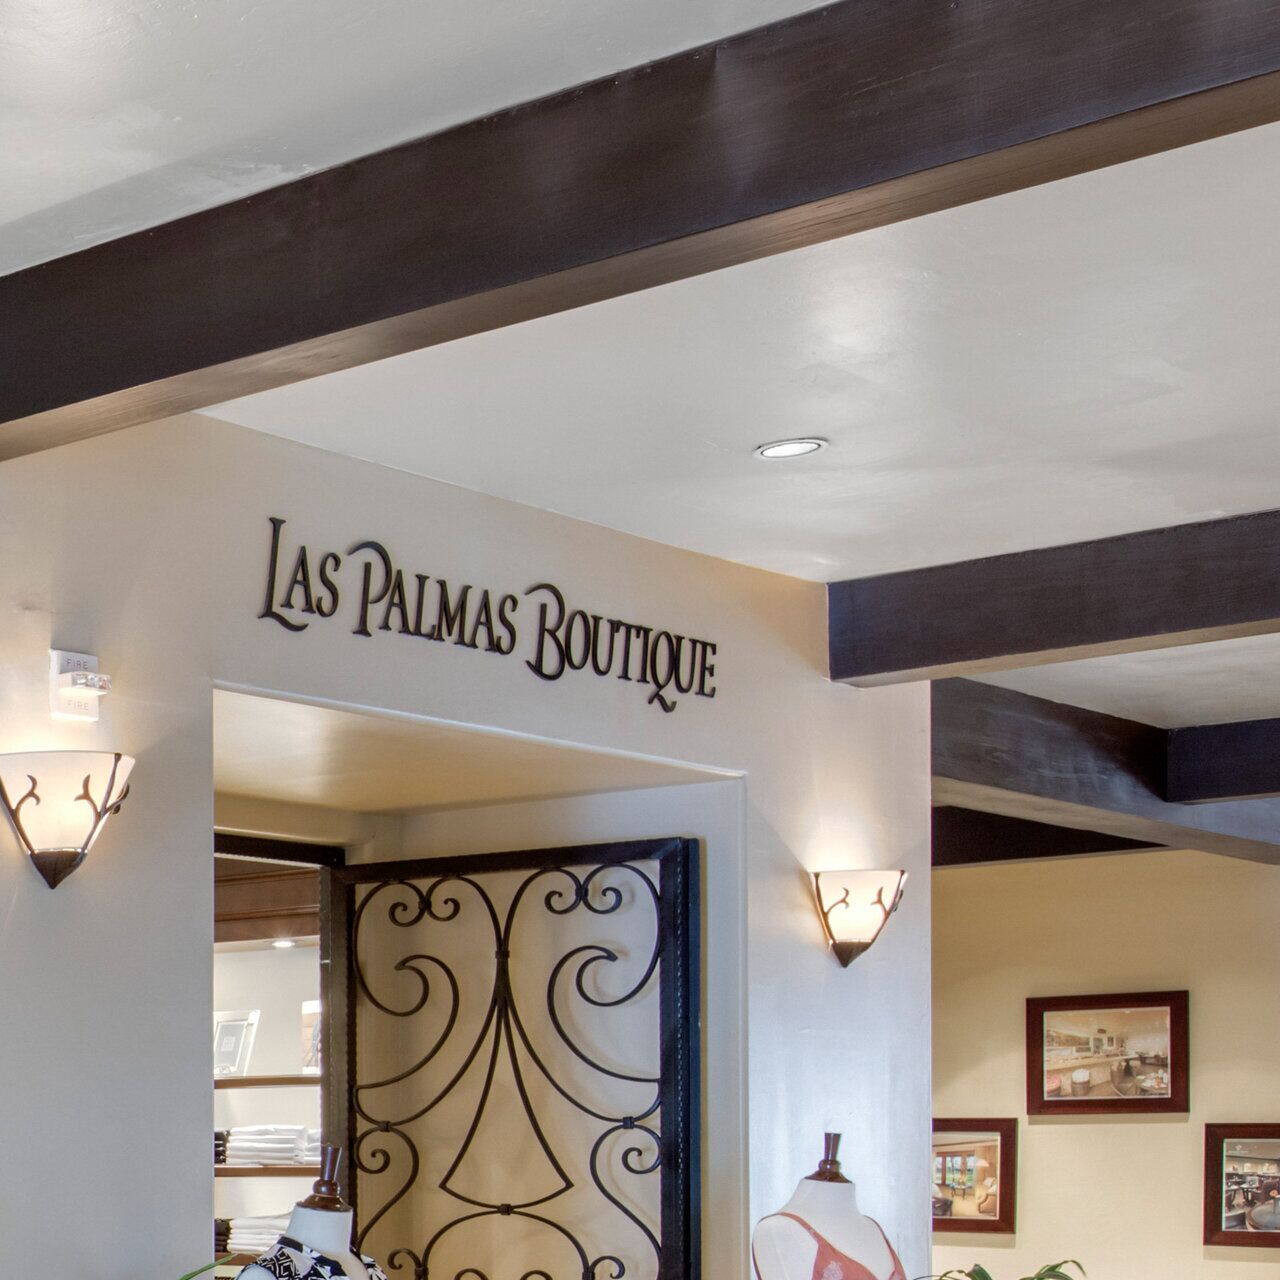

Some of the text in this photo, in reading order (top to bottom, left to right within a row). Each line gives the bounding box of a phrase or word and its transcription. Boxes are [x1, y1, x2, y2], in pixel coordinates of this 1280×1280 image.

[258, 517, 717, 713] LAS PALMAS BOUTIQUE
[66, 658, 89, 670] FIRE
[67, 699, 89, 711] FIRE
